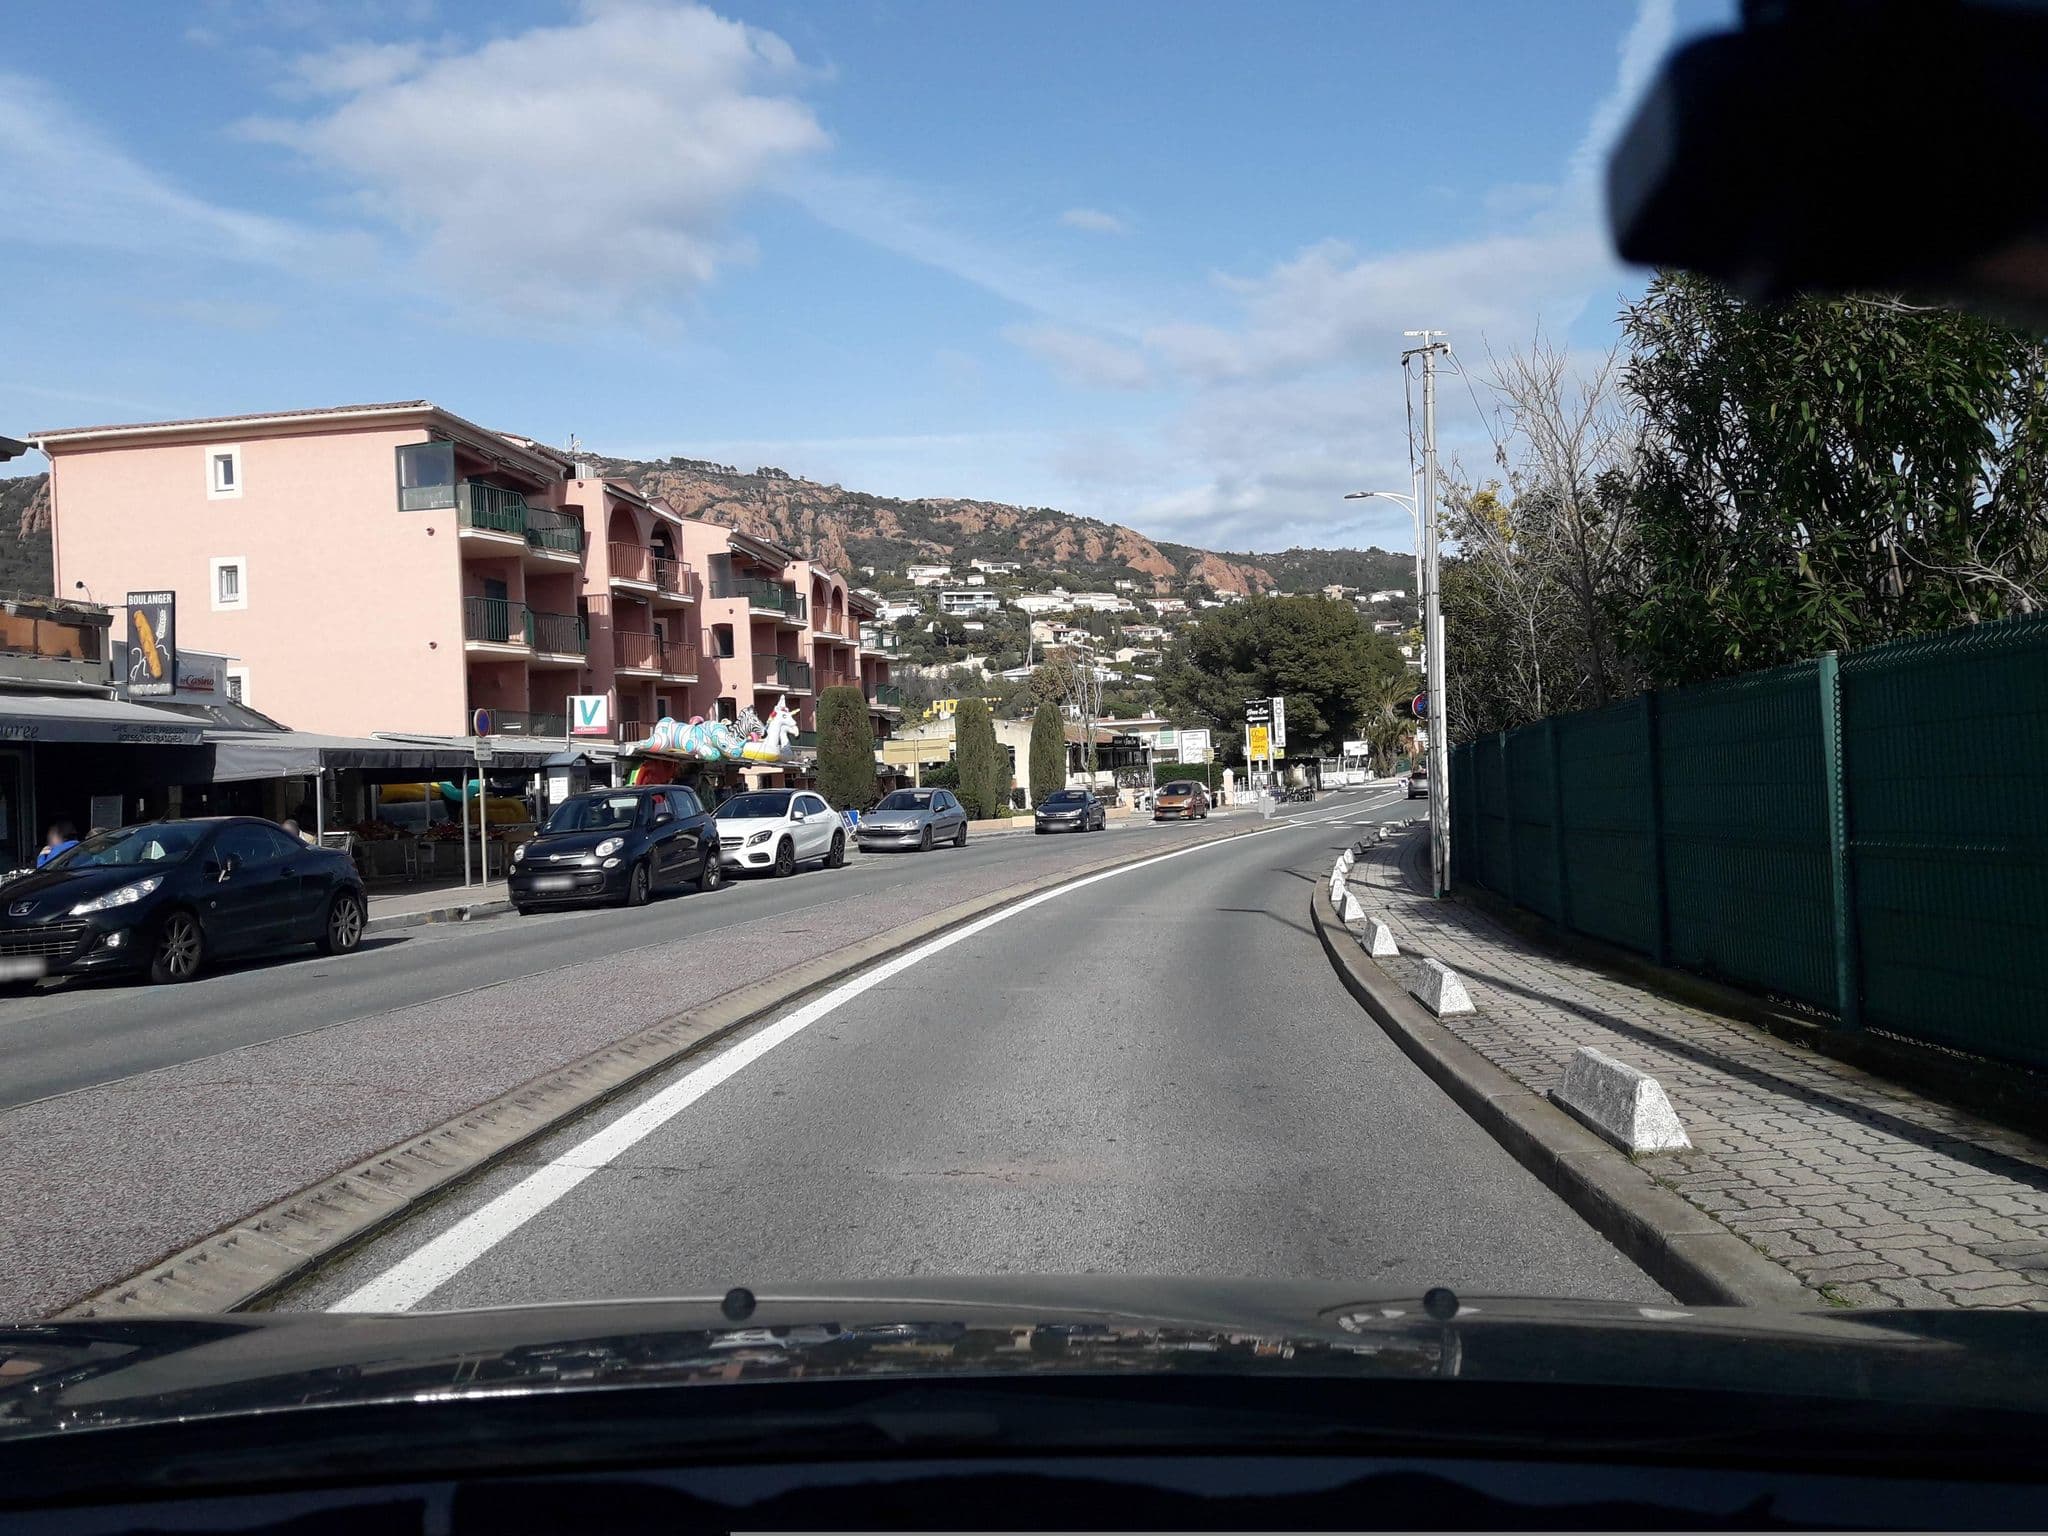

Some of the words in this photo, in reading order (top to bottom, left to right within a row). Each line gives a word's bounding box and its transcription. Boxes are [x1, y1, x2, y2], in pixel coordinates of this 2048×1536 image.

[128, 593, 172, 605] BOULANGER
[185, 674, 214, 688] Casino
[579, 699, 601, 726] V
